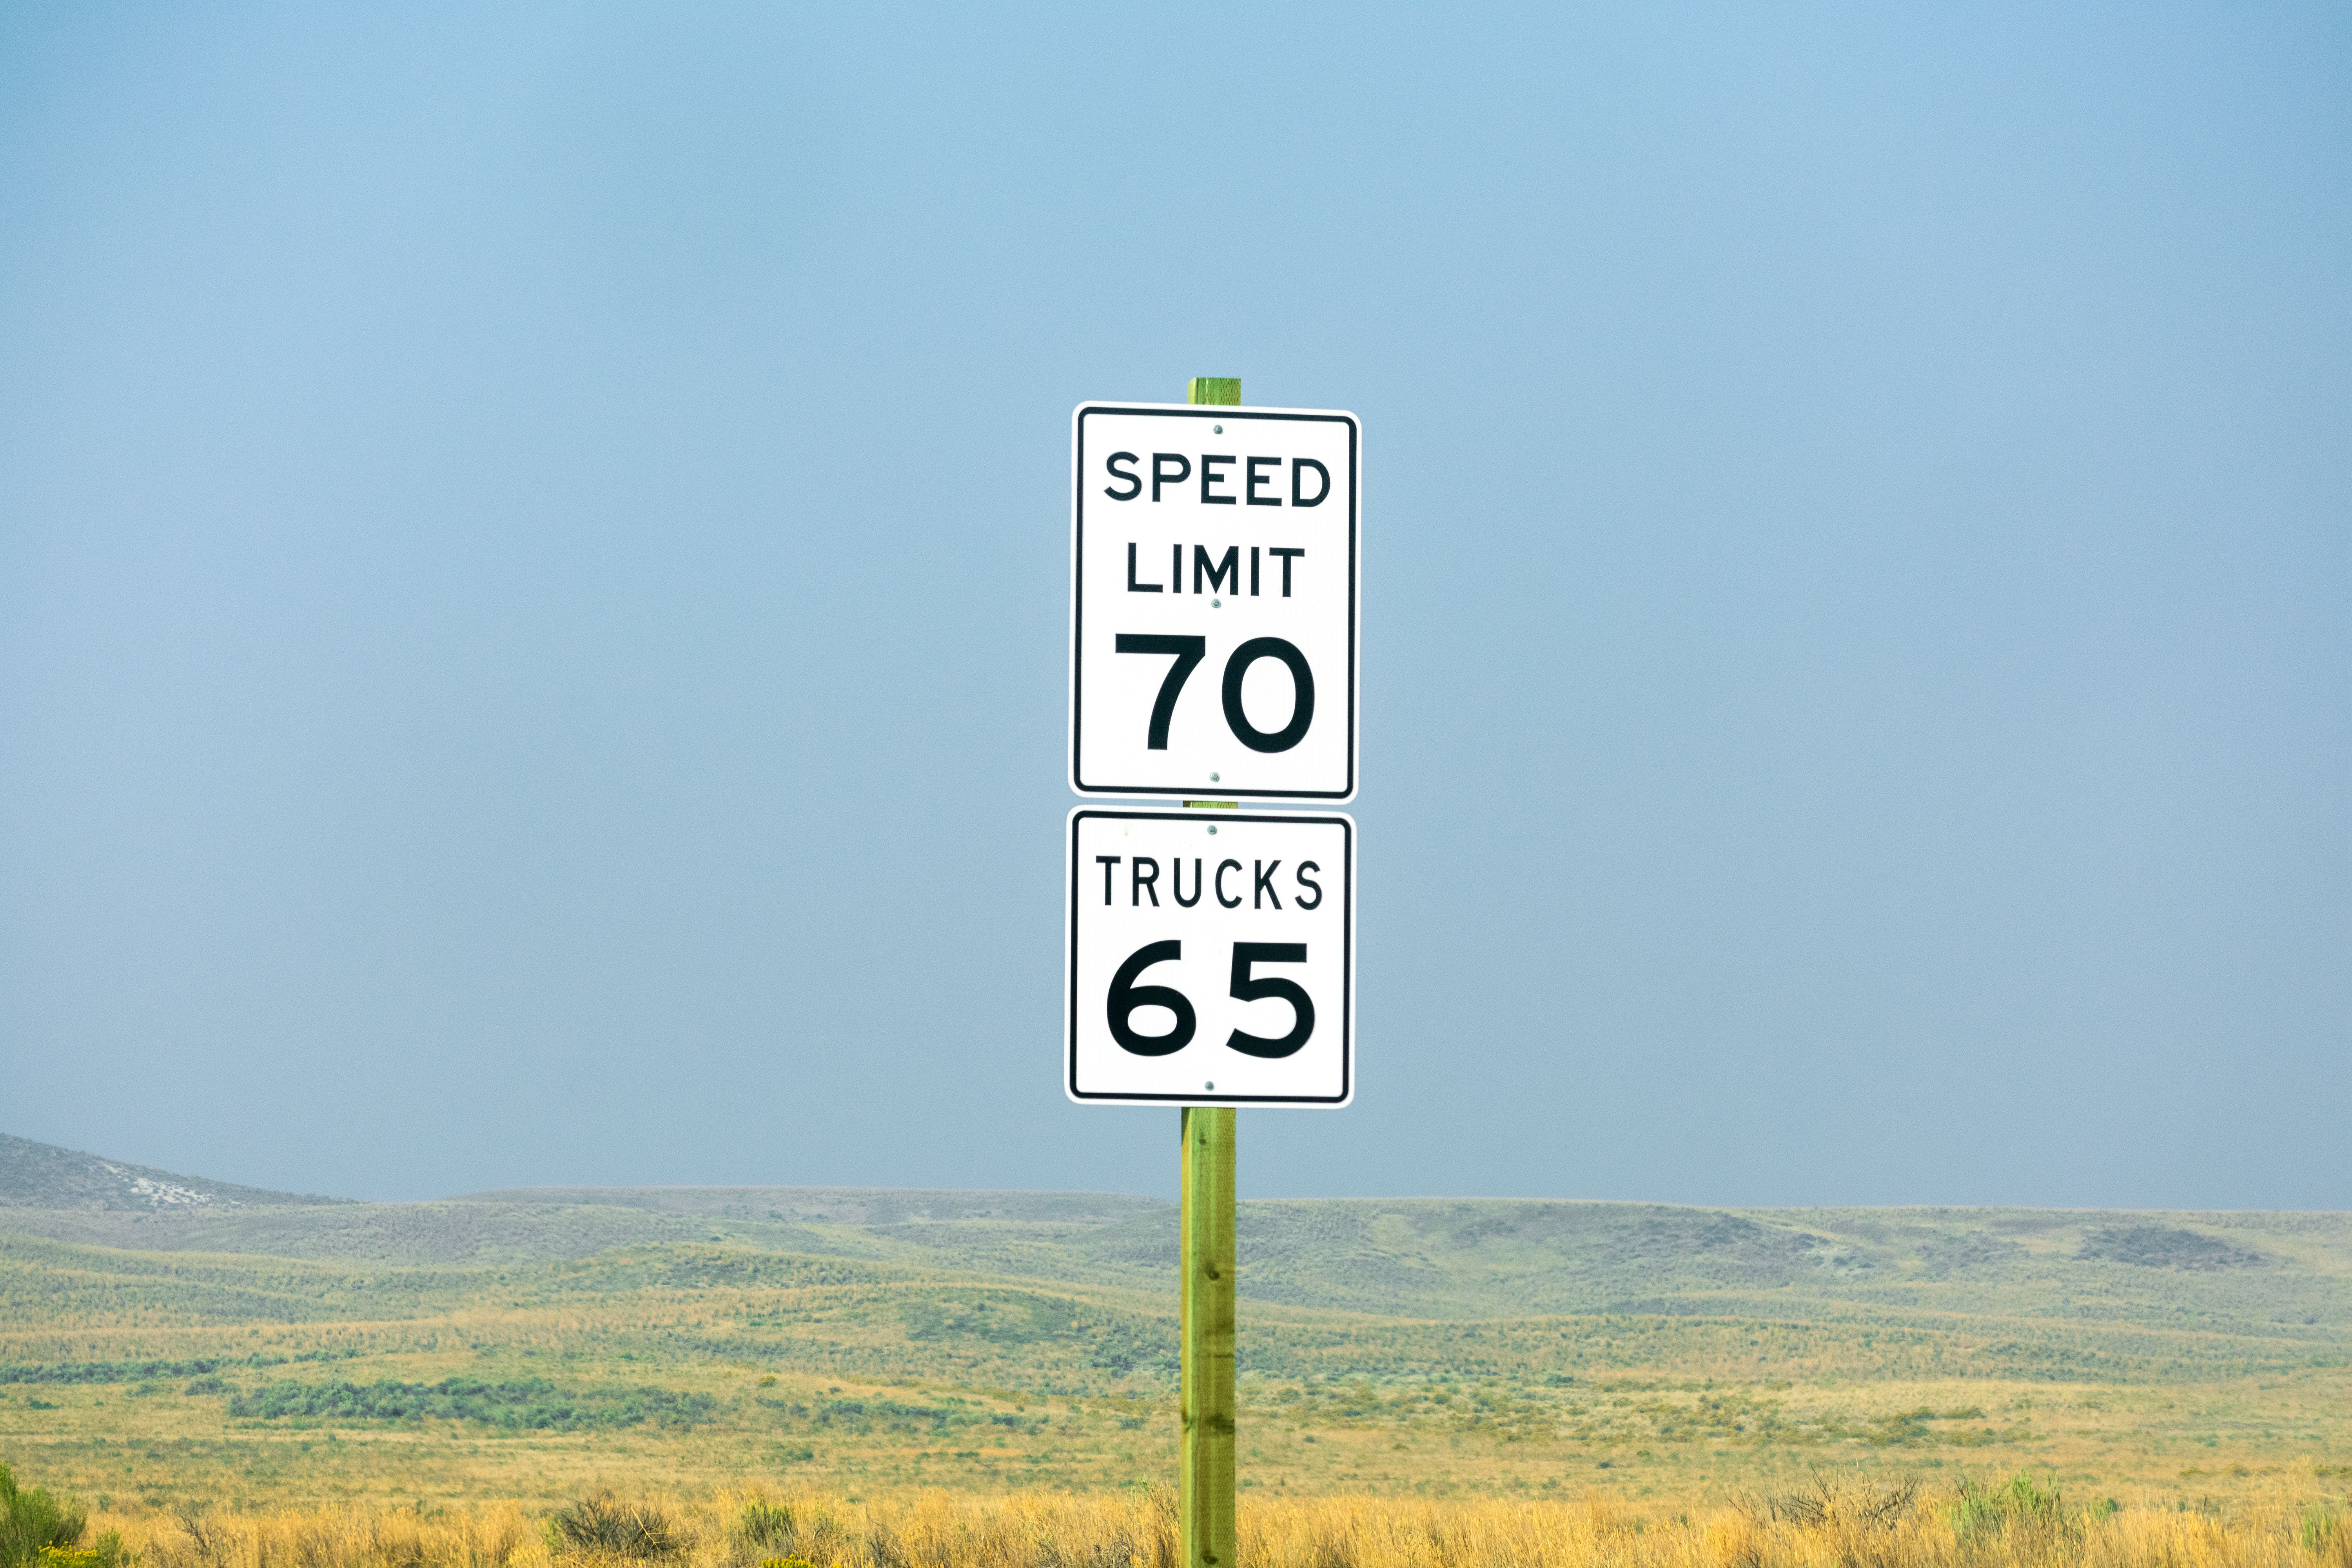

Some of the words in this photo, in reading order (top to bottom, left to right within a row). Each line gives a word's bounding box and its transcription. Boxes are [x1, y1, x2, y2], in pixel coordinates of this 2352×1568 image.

[1104, 451, 1331, 508] SPEED
[1127, 542, 1305, 598] LIMIT
[1115, 633, 1315, 754] 70
[1095, 855, 1322, 911] TRUCKS
[1106, 939, 1315, 1059] 65
